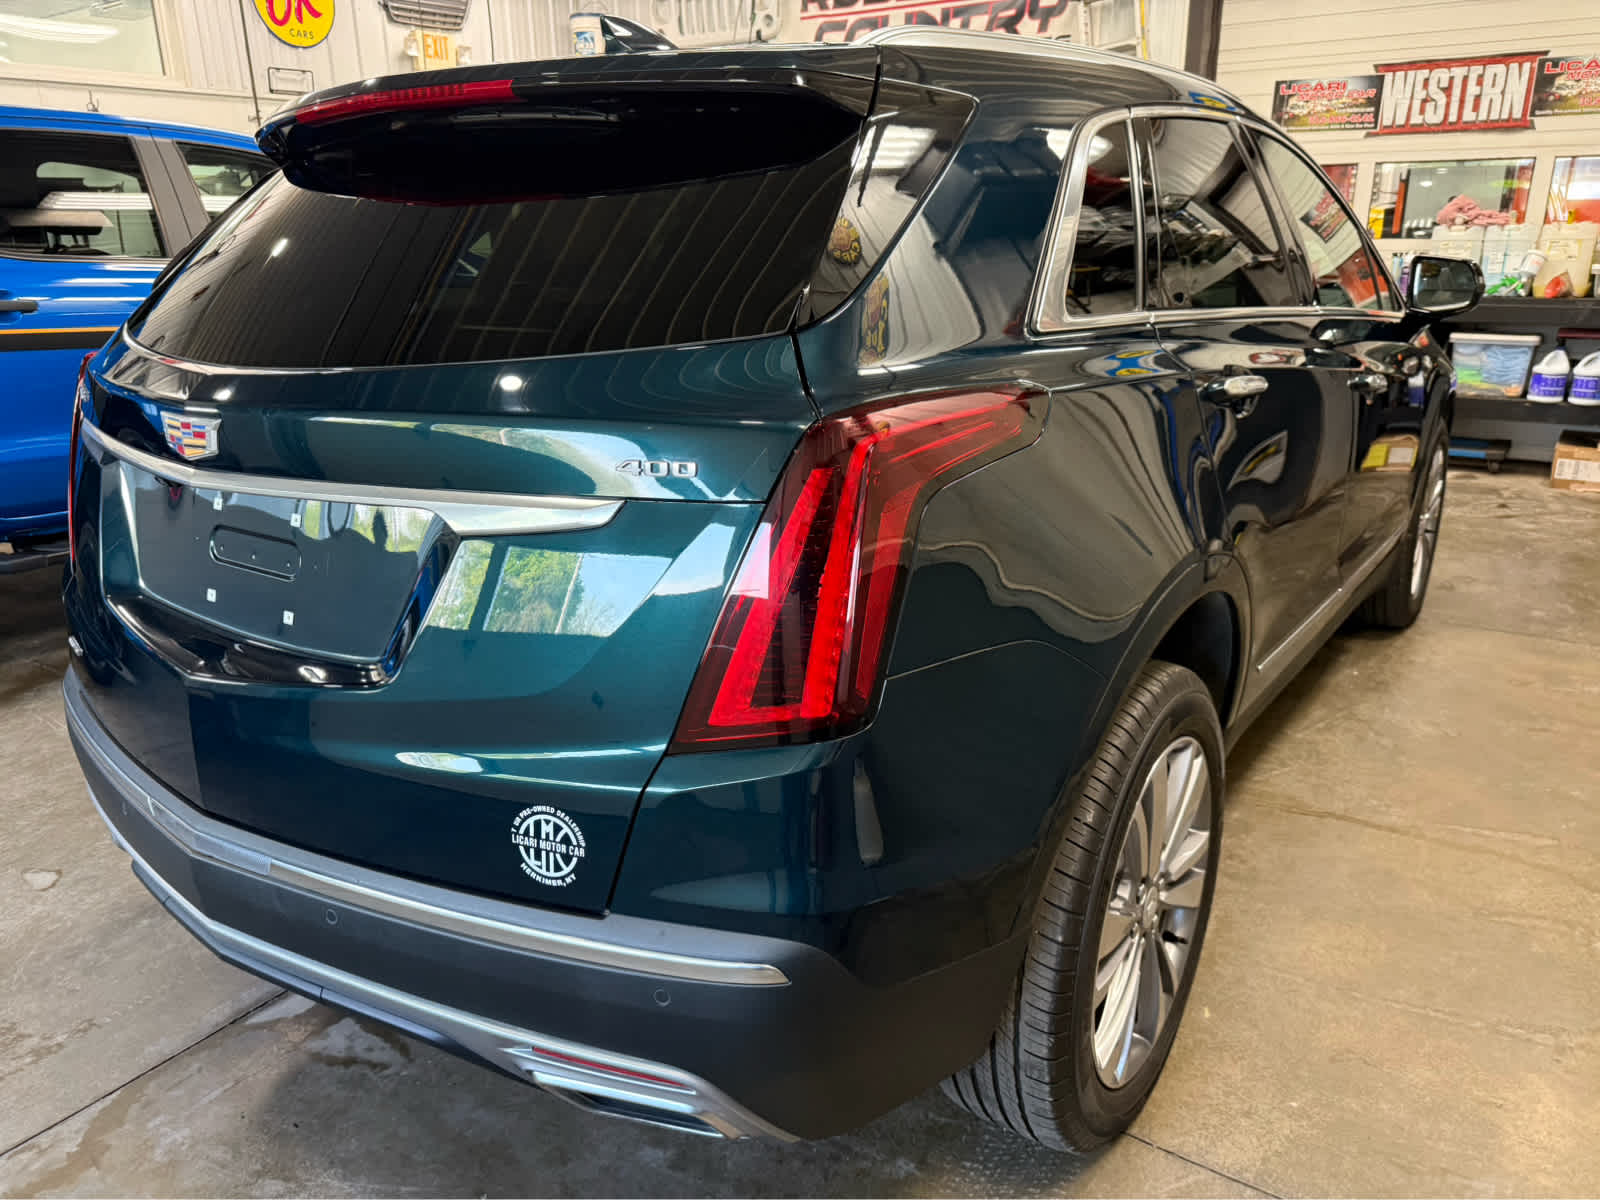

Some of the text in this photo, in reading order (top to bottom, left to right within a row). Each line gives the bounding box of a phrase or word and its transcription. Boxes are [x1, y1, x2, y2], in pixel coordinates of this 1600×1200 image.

[289, 28, 314, 39] CARS
[423, 34, 449, 60] EXIT
[1280, 82, 1347, 95] LICARI
[1382, 62, 1532, 127] WESTERN
[616, 460, 698, 477] 400
[519, 805, 555, 819] PRE-OWNED
[556, 810, 586, 847] DEALERSHIP
[511, 833, 585, 858] LICARI MOTOR CAR
